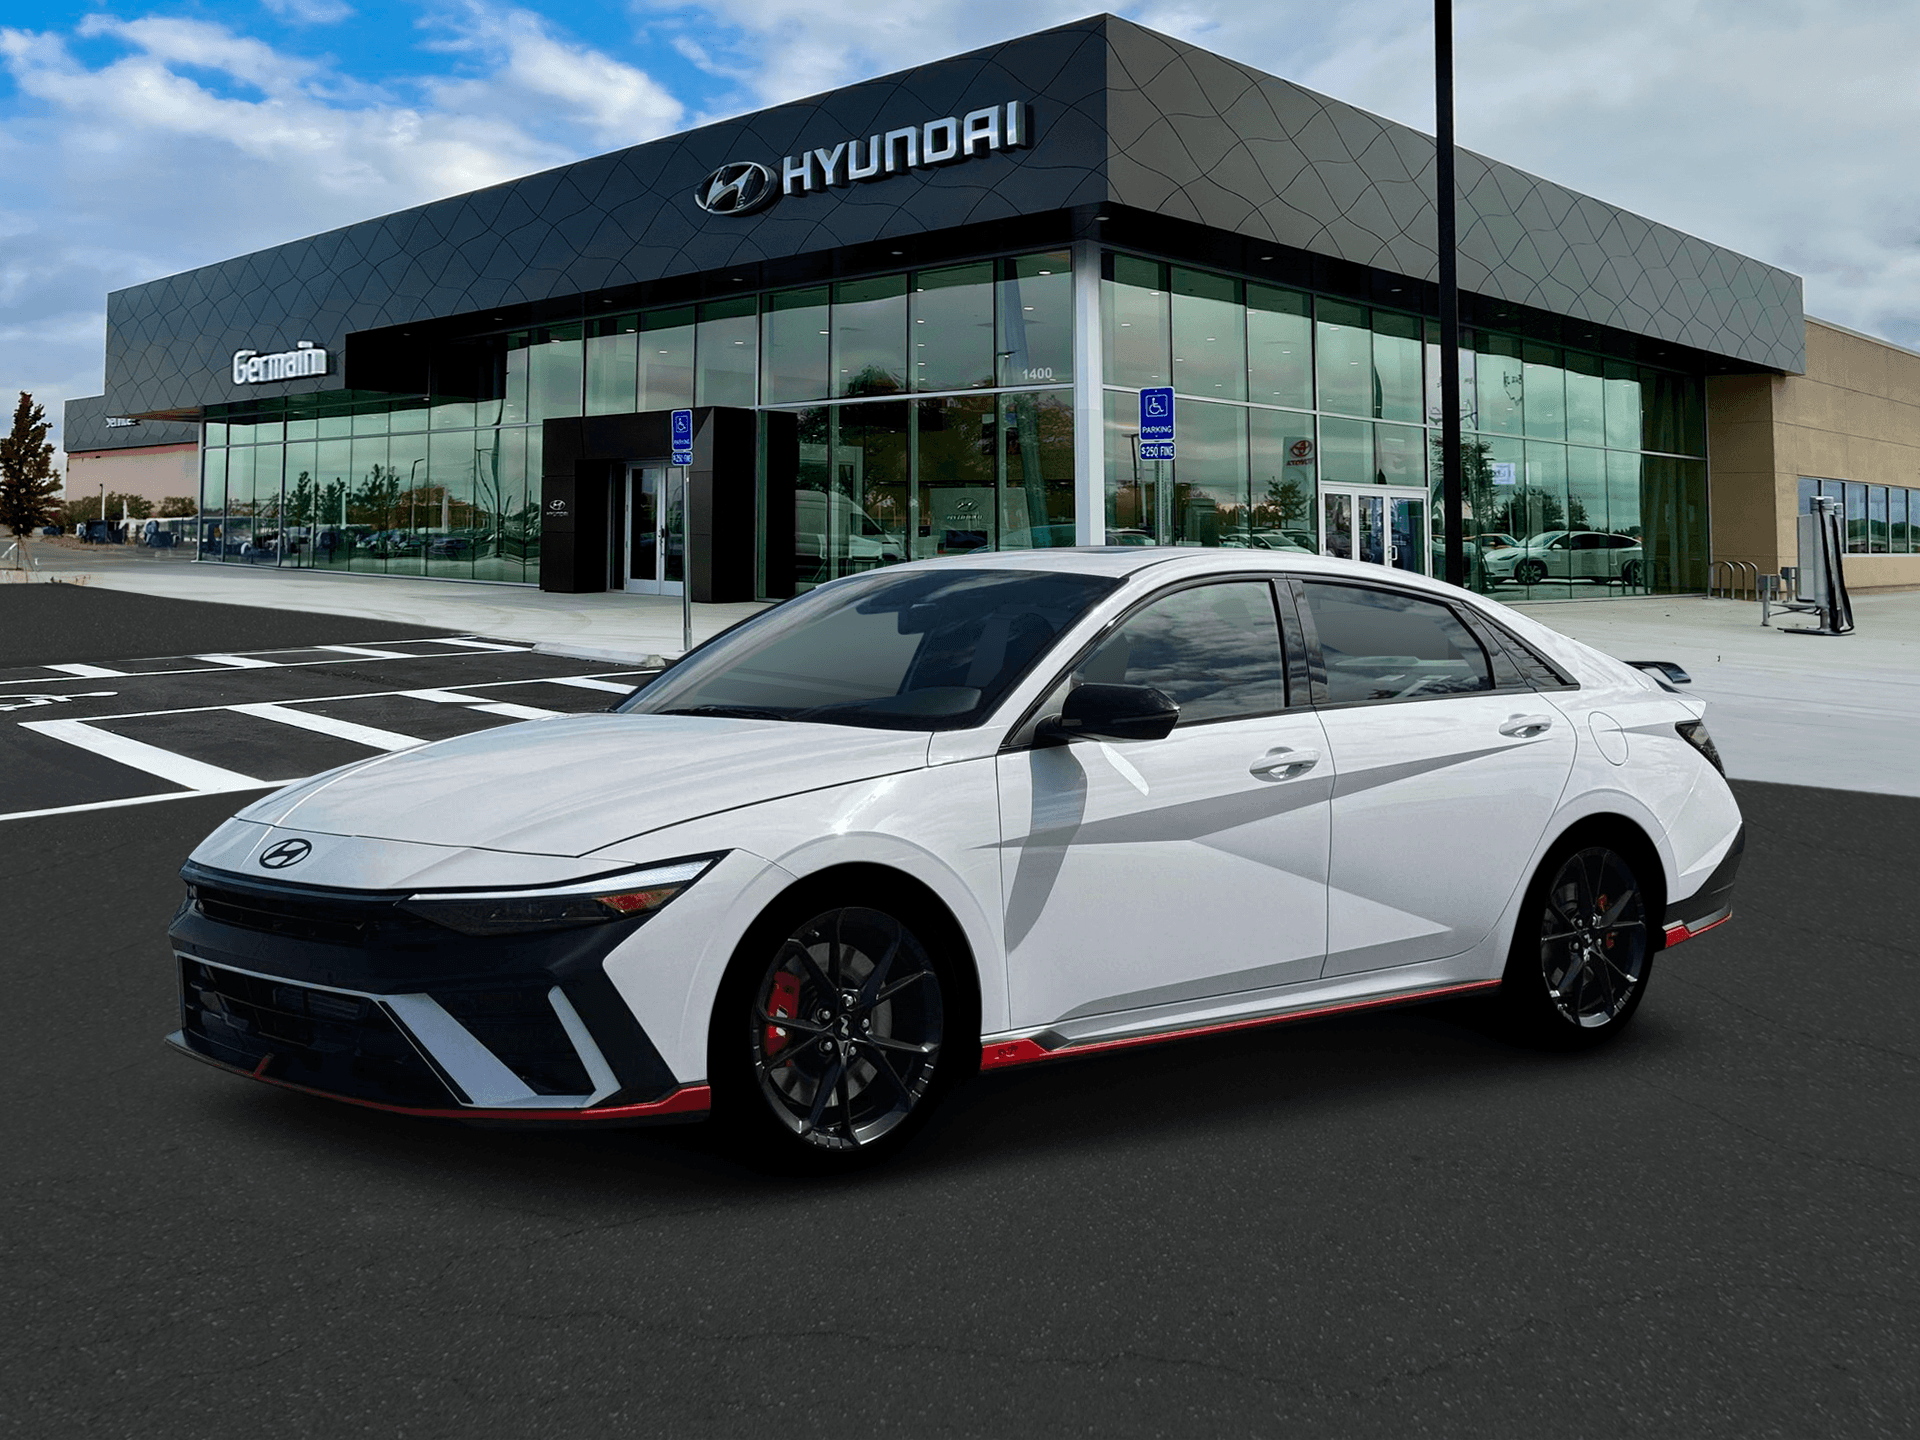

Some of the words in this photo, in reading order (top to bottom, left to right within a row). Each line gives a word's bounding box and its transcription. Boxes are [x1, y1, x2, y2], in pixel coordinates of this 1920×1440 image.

[783, 100, 1022, 195] HYUNDAI
[232, 340, 327, 385] Germain
[1022, 367, 1052, 380] 1400
[1142, 425, 1171, 434] PARKING
[1141, 446, 1159, 457] $250
[1160, 446, 1173, 456] FINE
